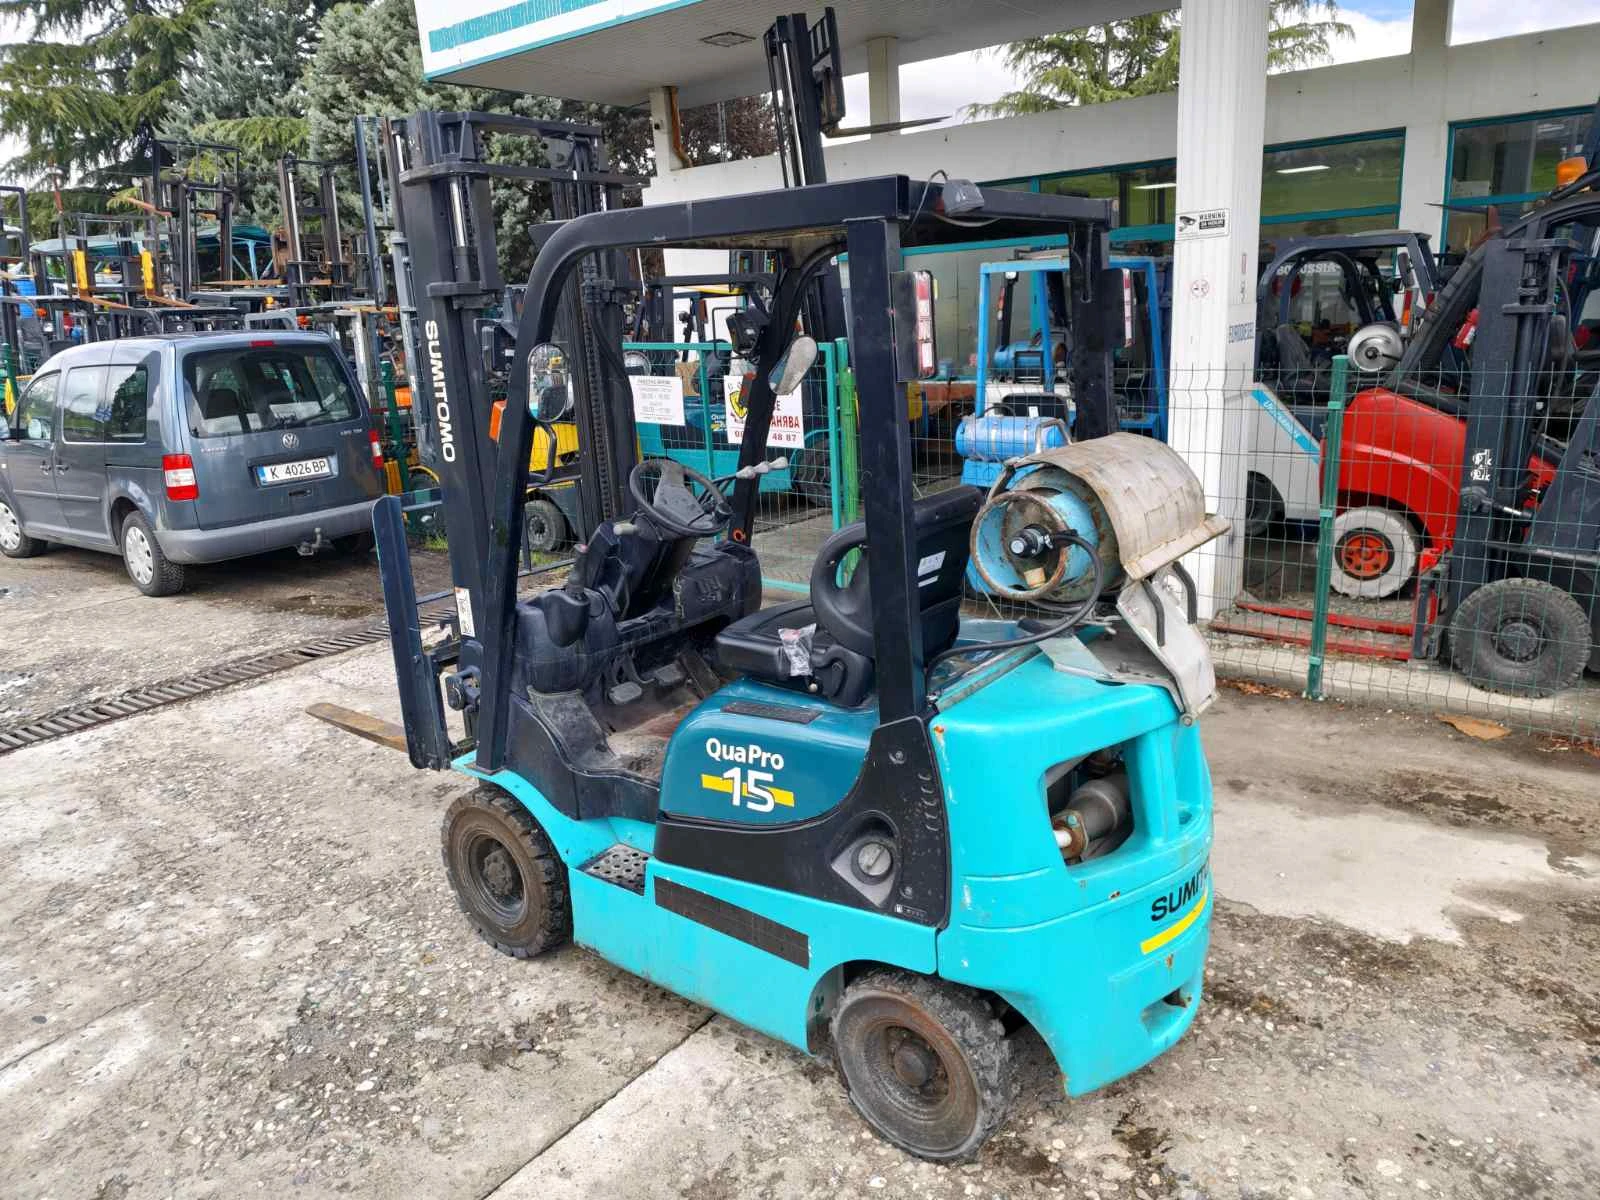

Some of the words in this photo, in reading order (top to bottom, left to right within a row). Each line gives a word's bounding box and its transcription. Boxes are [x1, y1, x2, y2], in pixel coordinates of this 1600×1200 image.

[425, 320, 456, 463] SUMITOMO
[771, 416, 800, 429] АНЯВА
[270, 467, 279, 480] K
[285, 462, 311, 477] 4026
[705, 737, 785, 770] QuaPro
[722, 765, 776, 813] 15
